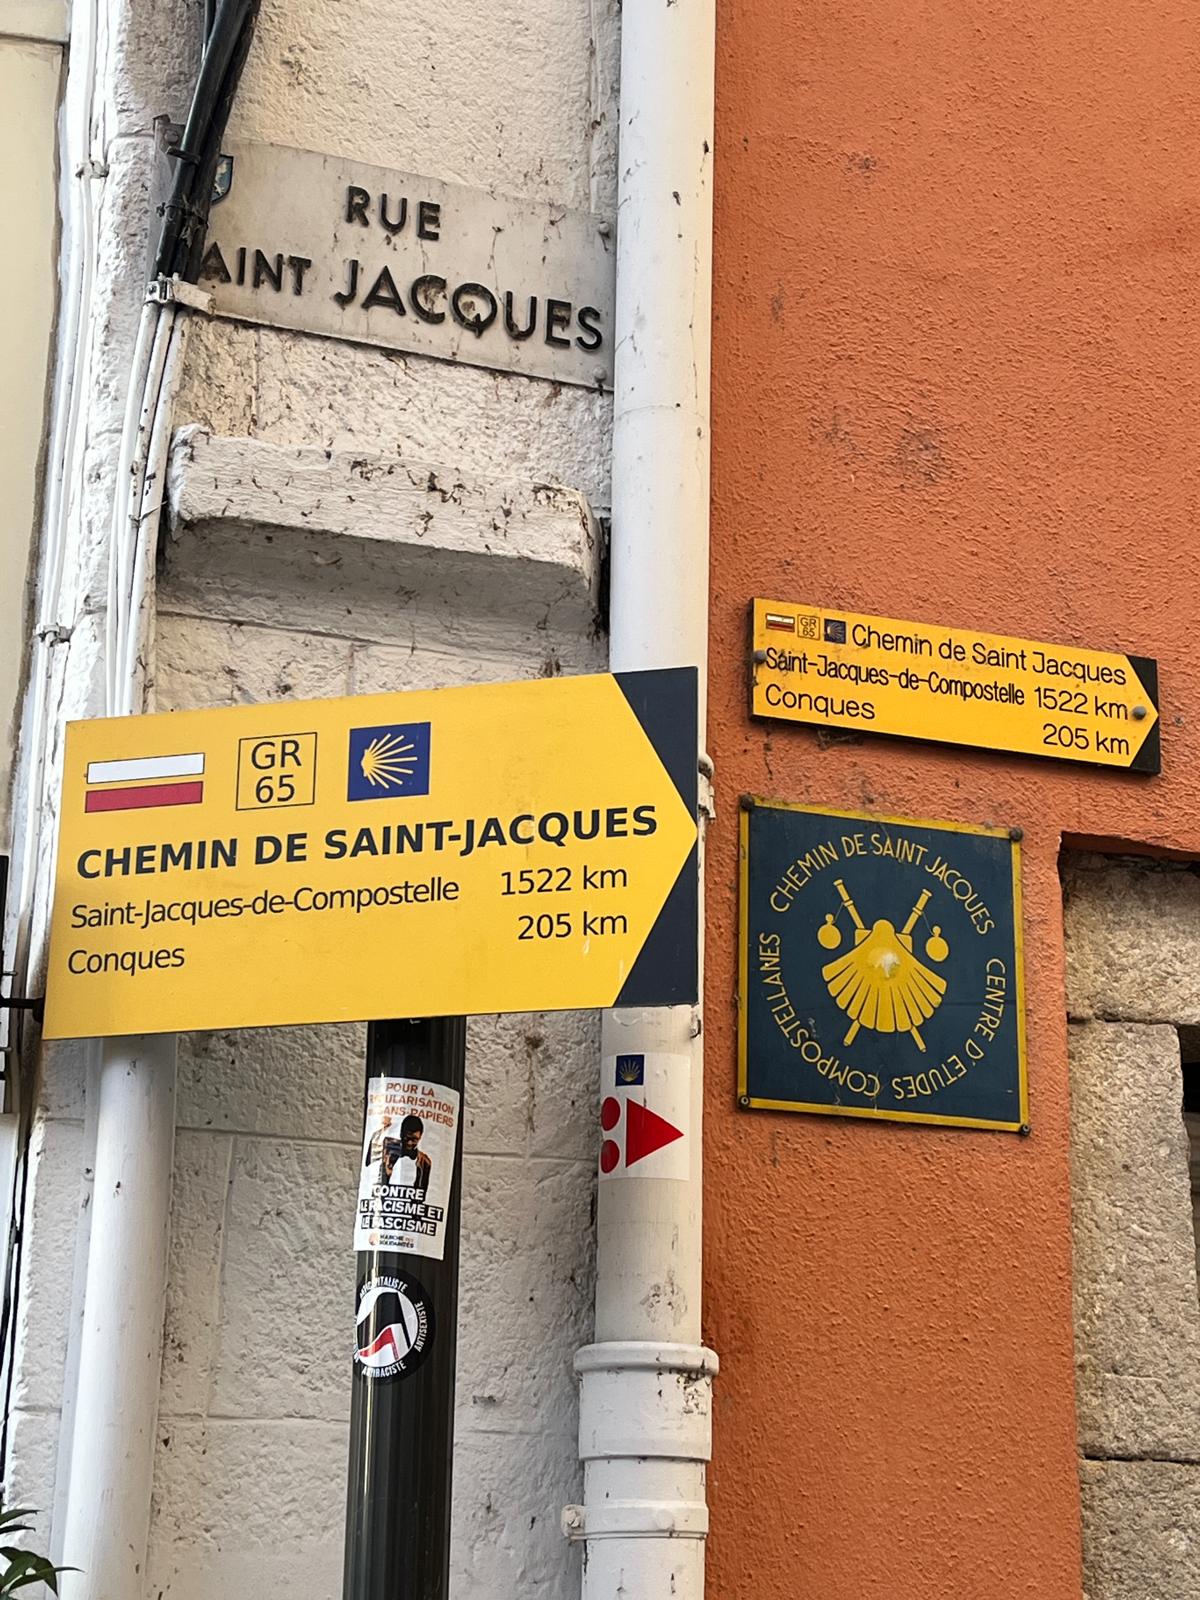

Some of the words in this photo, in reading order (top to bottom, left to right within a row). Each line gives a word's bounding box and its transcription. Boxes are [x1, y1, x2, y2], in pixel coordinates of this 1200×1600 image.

[346, 184, 441, 241] RUE
[200, 241, 312, 296] AINT
[334, 259, 603, 352] JACQUES
[799, 617, 817, 629] GR
[802, 627, 816, 638] 65
[852, 623, 933, 657] Chemin
[938, 638, 966, 662] de
[972, 642, 1027, 671] Saint
[1032, 651, 1127, 686] Jacques
[765, 647, 1025, 706] Saint-Jacques-de-Compostelle
[1034, 686, 1089, 715] 1522
[1095, 695, 1128, 720] km
[765, 683, 876, 720] Conques
[1043, 723, 1090, 750] 205
[1096, 731, 1130, 756] km
[250, 739, 303, 770] GR
[255, 774, 296, 804] 65
[76, 838, 238, 879] CHEMIN
[254, 833, 308, 865] DE
[324, 805, 657, 859] SAINT-JACQUES
[71, 876, 460, 929] Saint-Jacques-de-Compostelle
[500, 866, 572, 896] 1522
[583, 865, 628, 890] km
[770, 841, 840, 913] CHEMIN
[841, 833, 867, 858] DE
[870, 833, 928, 866] SAINT
[925, 856, 996, 935] JACQUES
[67, 948, 185, 976] Conques
[517, 913, 572, 940] 205
[582, 911, 628, 936] km
[758, 932, 881, 1097] COMPOSTELLANES
[973, 958, 1007, 1042] CENTRE
[386, 1082, 418, 1094] POUR
[421, 1085, 435, 1097] LA
[369, 1200, 425, 1216] RACISME
[427, 1207, 443, 1220] ET
[373, 1185, 424, 1200] CONTRE
[414, 1301, 428, 1353] ANTISEXISTE
